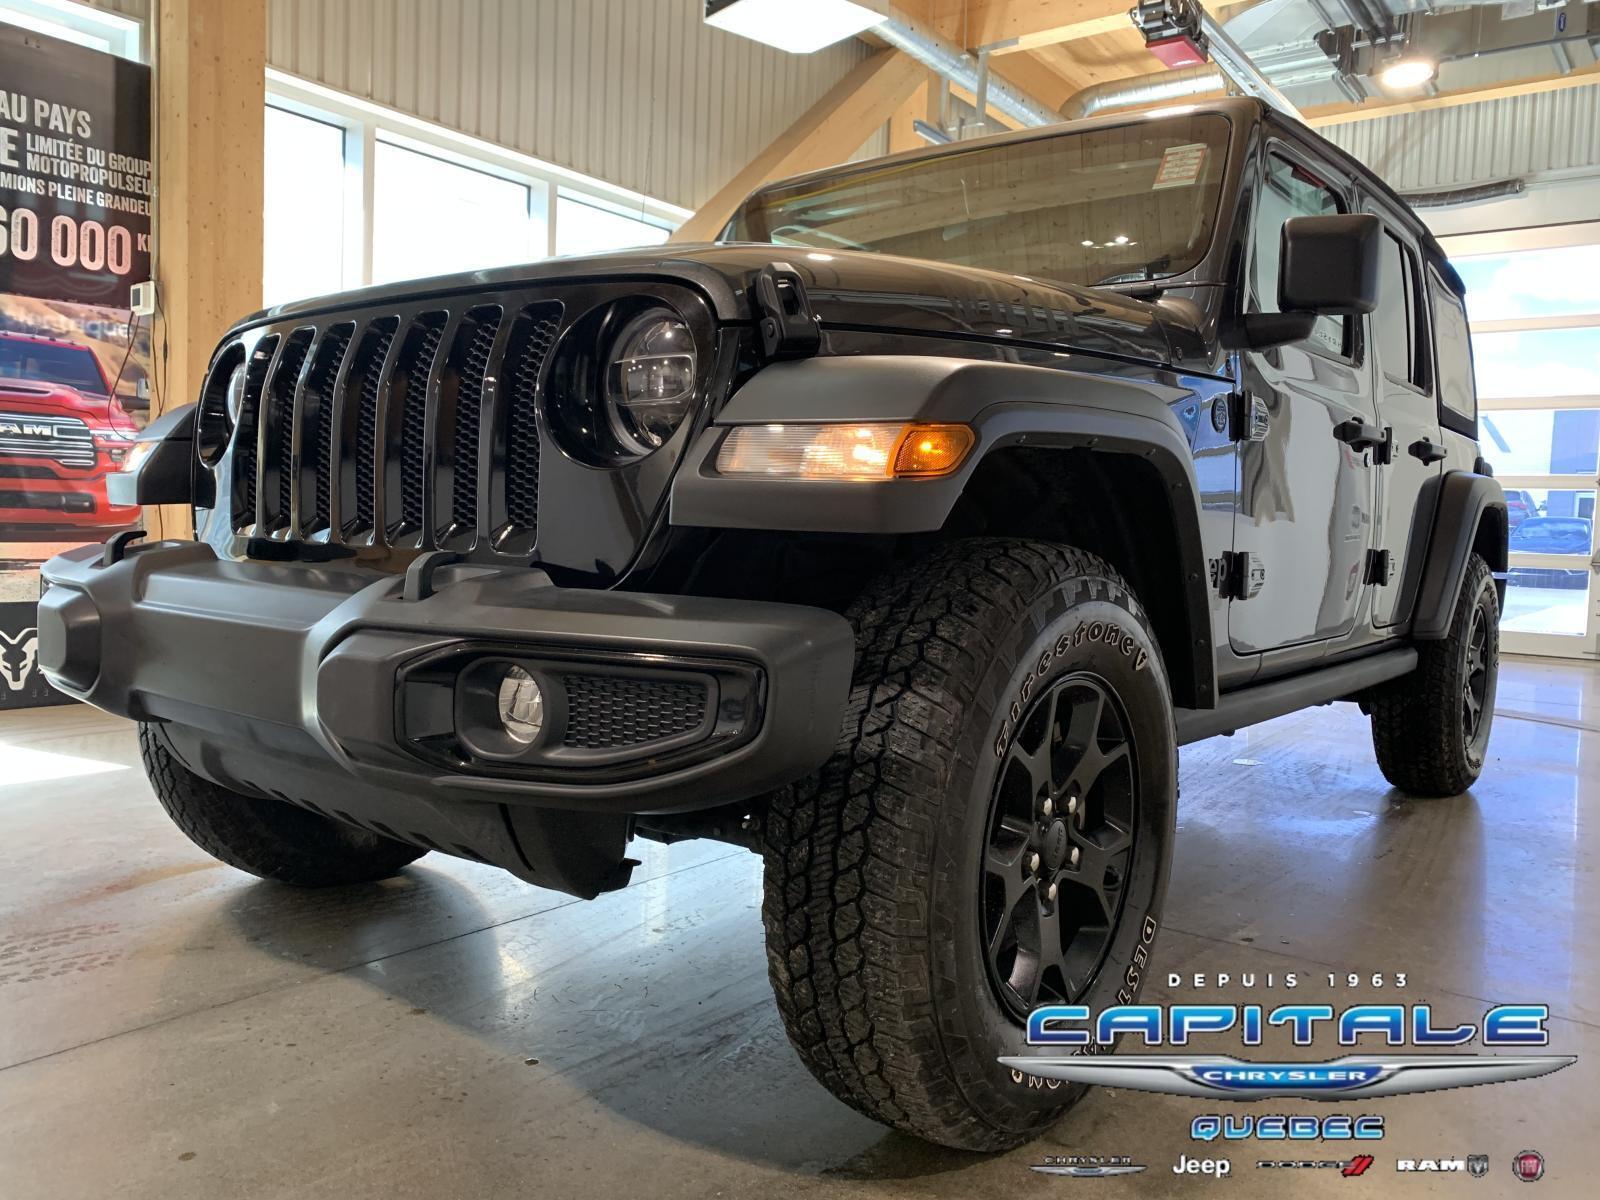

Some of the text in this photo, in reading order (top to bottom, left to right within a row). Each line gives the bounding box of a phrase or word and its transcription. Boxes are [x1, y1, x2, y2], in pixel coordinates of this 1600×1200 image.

[0, 89, 91, 138] AU PAYS
[26, 132, 84, 162] LIMITÉE
[86, 146, 105, 167] DU
[48, 181, 94, 206] PLEINE
[51, 215, 132, 275] 000
